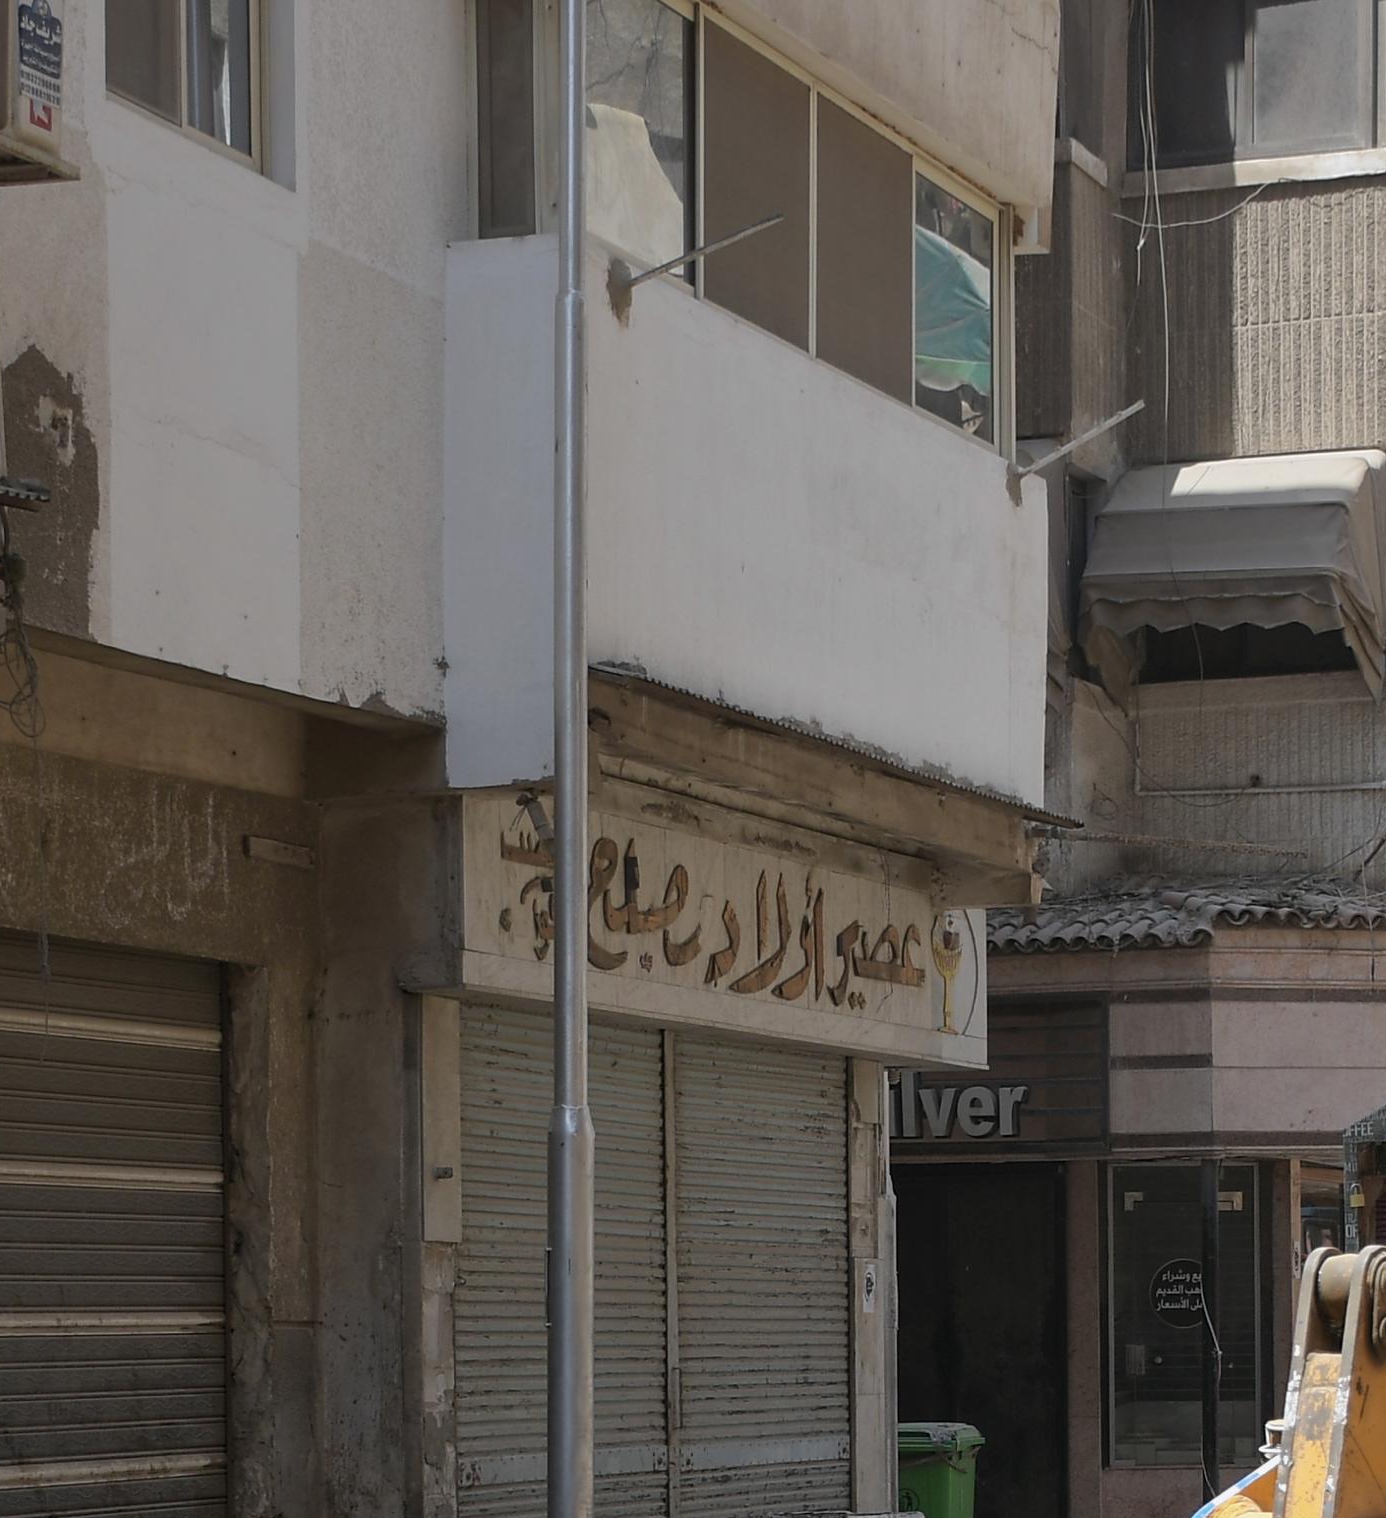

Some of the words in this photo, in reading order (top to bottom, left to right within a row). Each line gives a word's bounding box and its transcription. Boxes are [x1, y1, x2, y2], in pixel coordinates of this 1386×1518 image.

[827, 919, 926, 1010] عصير
[1162, 1269, 1191, 1283] وشراء
[1156, 1284, 1184, 1297] القديم
[1156, 1296, 1189, 1312] الأسعار
